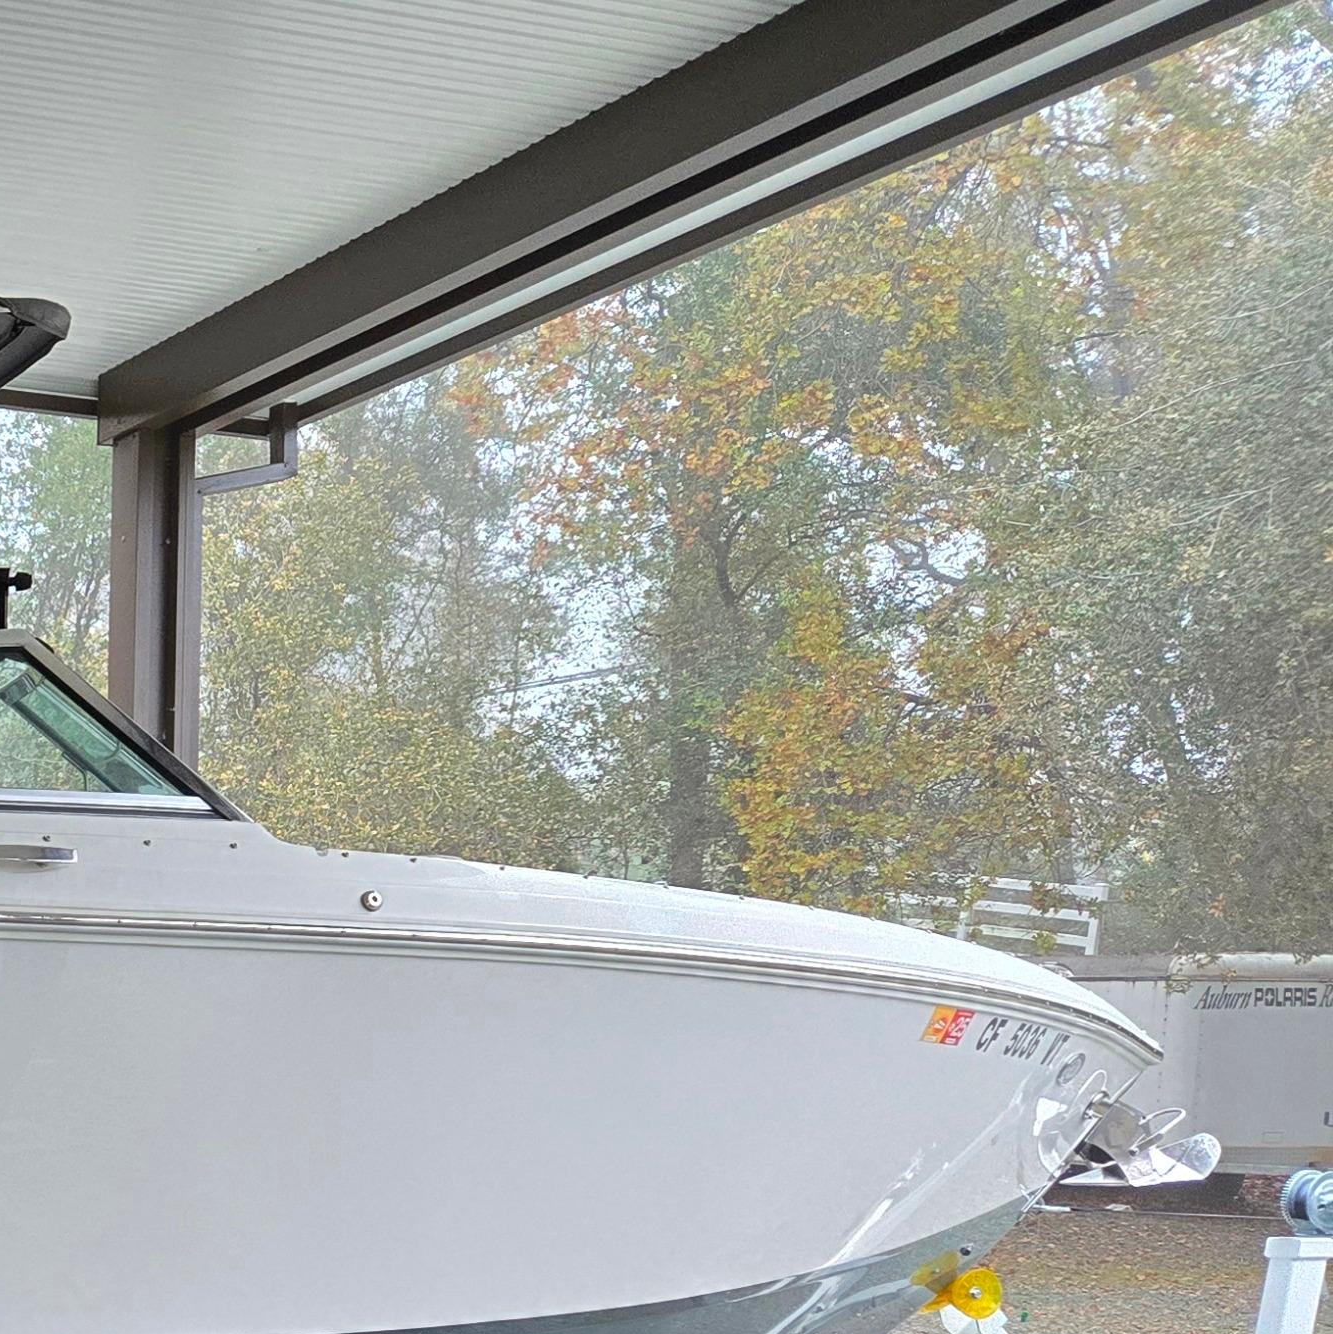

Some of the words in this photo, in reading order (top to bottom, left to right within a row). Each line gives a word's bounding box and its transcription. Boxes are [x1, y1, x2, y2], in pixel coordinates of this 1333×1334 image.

[1194, 985, 1252, 1010] Auburn
[1253, 987, 1318, 1008] POLARIS
[976, 1016, 1009, 1052] CF
[1003, 1022, 1048, 1060] 5036
